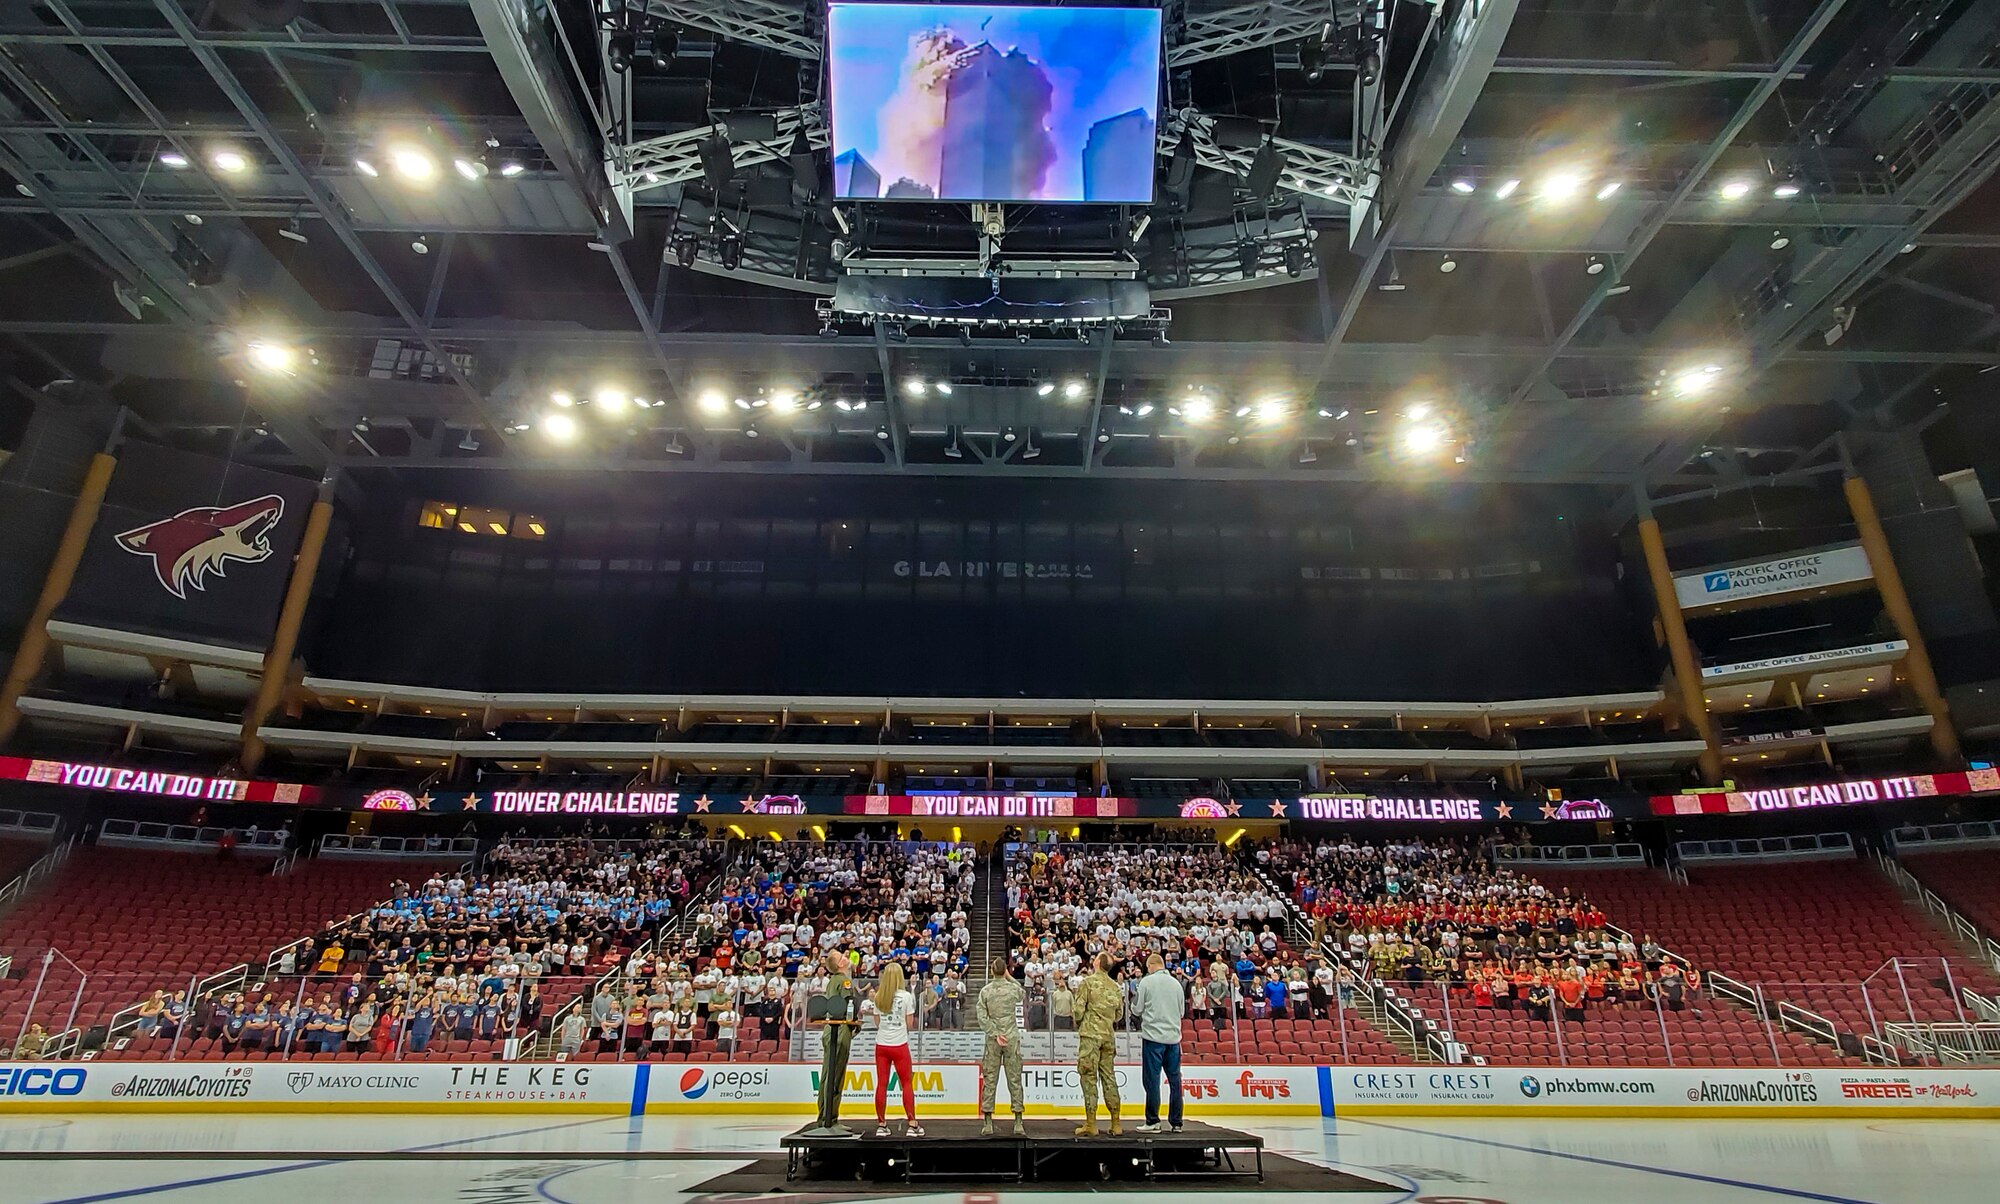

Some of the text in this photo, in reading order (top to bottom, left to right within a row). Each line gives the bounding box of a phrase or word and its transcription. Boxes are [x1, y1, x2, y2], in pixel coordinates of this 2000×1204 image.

[893, 560, 951, 578] GLA
[1729, 556, 1822, 579] PACIFIC OFFICE
[1732, 567, 1818, 589] AUTOMATION
[1734, 646, 1873, 671] PACIFIC OFFICE AUTOMATION
[61, 763, 237, 800] YOU CAN DO IT!
[493, 791, 680, 814] TOWER CHALLENGE
[1743, 777, 1915, 811] YOU CAN DO IT!
[924, 796, 1054, 817] YOU CAN DO IT!
[1300, 798, 1483, 820] TOWER CHALLENGE
[317, 1076, 419, 1088] MAYO CLINIC
[451, 1067, 590, 1085] THE KEG
[712, 1068, 768, 1089] pepsi
[1235, 1070, 1291, 1100] fry's
[1353, 1073, 1492, 1091] CREST CREST
[446, 1090, 545, 1100] STEAKHOUSE
[559, 1091, 587, 1100] BAR
[1545, 1078, 1655, 1096] phxbmw.com
[1841, 1084, 1913, 1098] STREETS
[1915, 1087, 1928, 1095] OF
